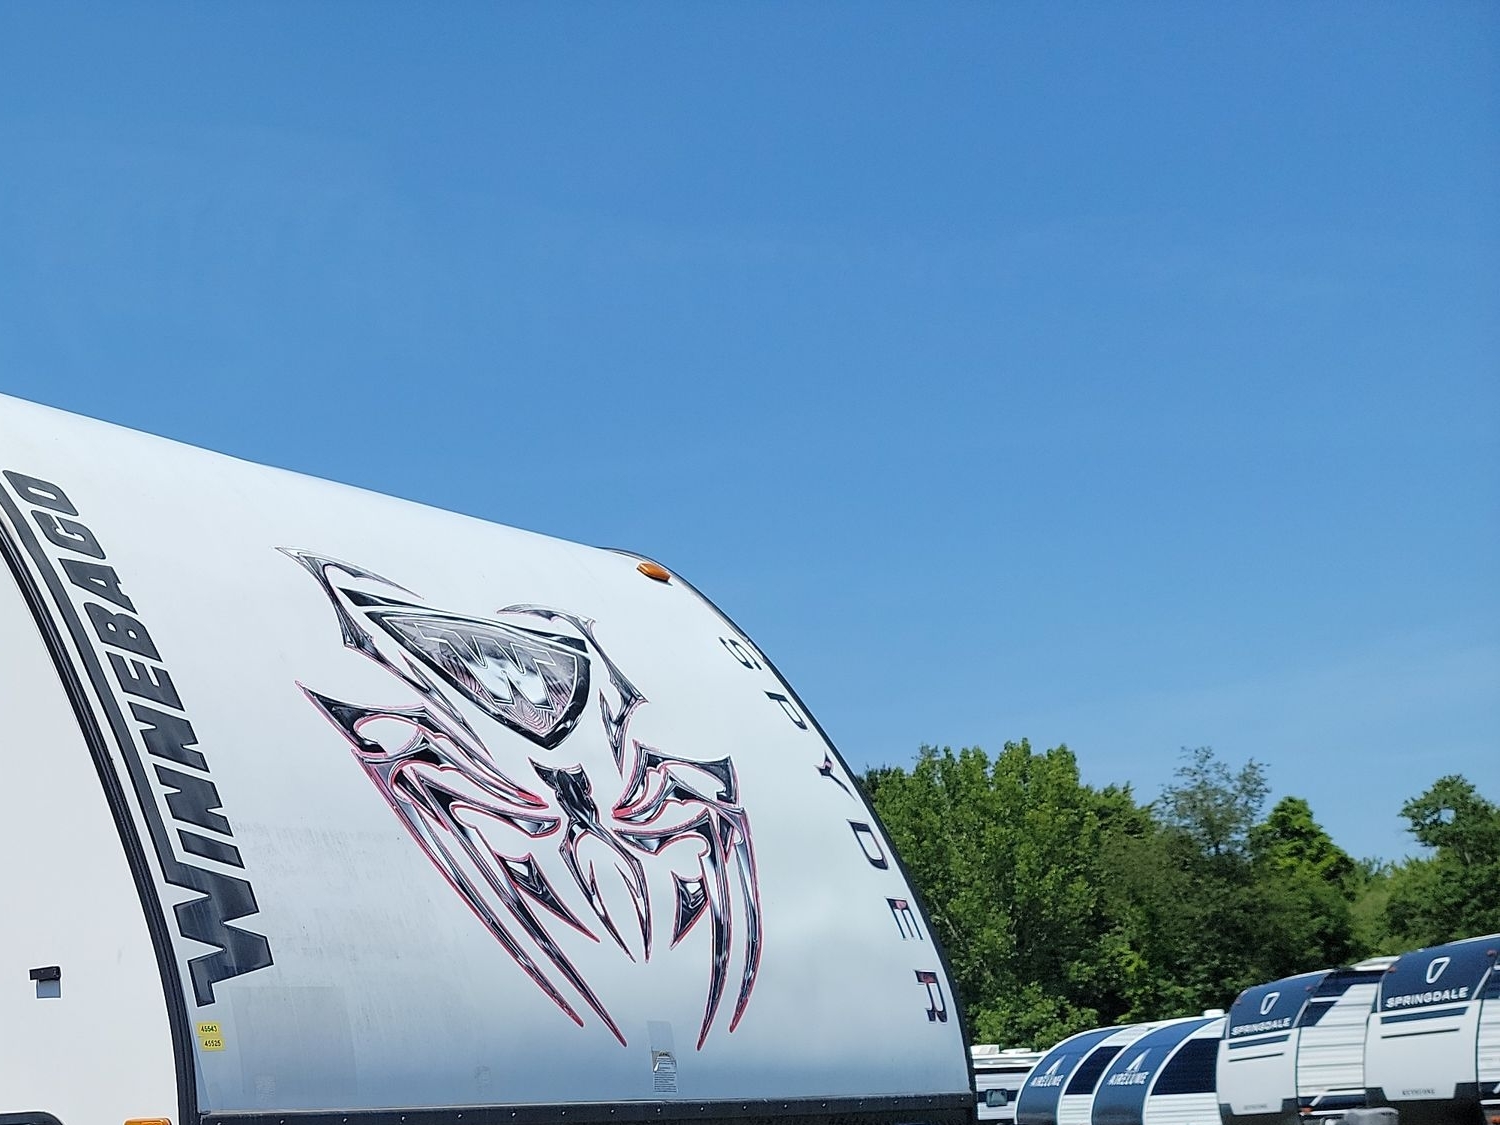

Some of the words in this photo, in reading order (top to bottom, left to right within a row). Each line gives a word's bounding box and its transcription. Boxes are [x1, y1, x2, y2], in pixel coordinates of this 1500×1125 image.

[2, 469, 275, 1008] WINNEBAGO
[719, 636, 948, 1023] SPYDER
[1230, 1016, 1291, 1036] SPRINGDALE
[1385, 986, 1469, 1008] SPRINGDALE
